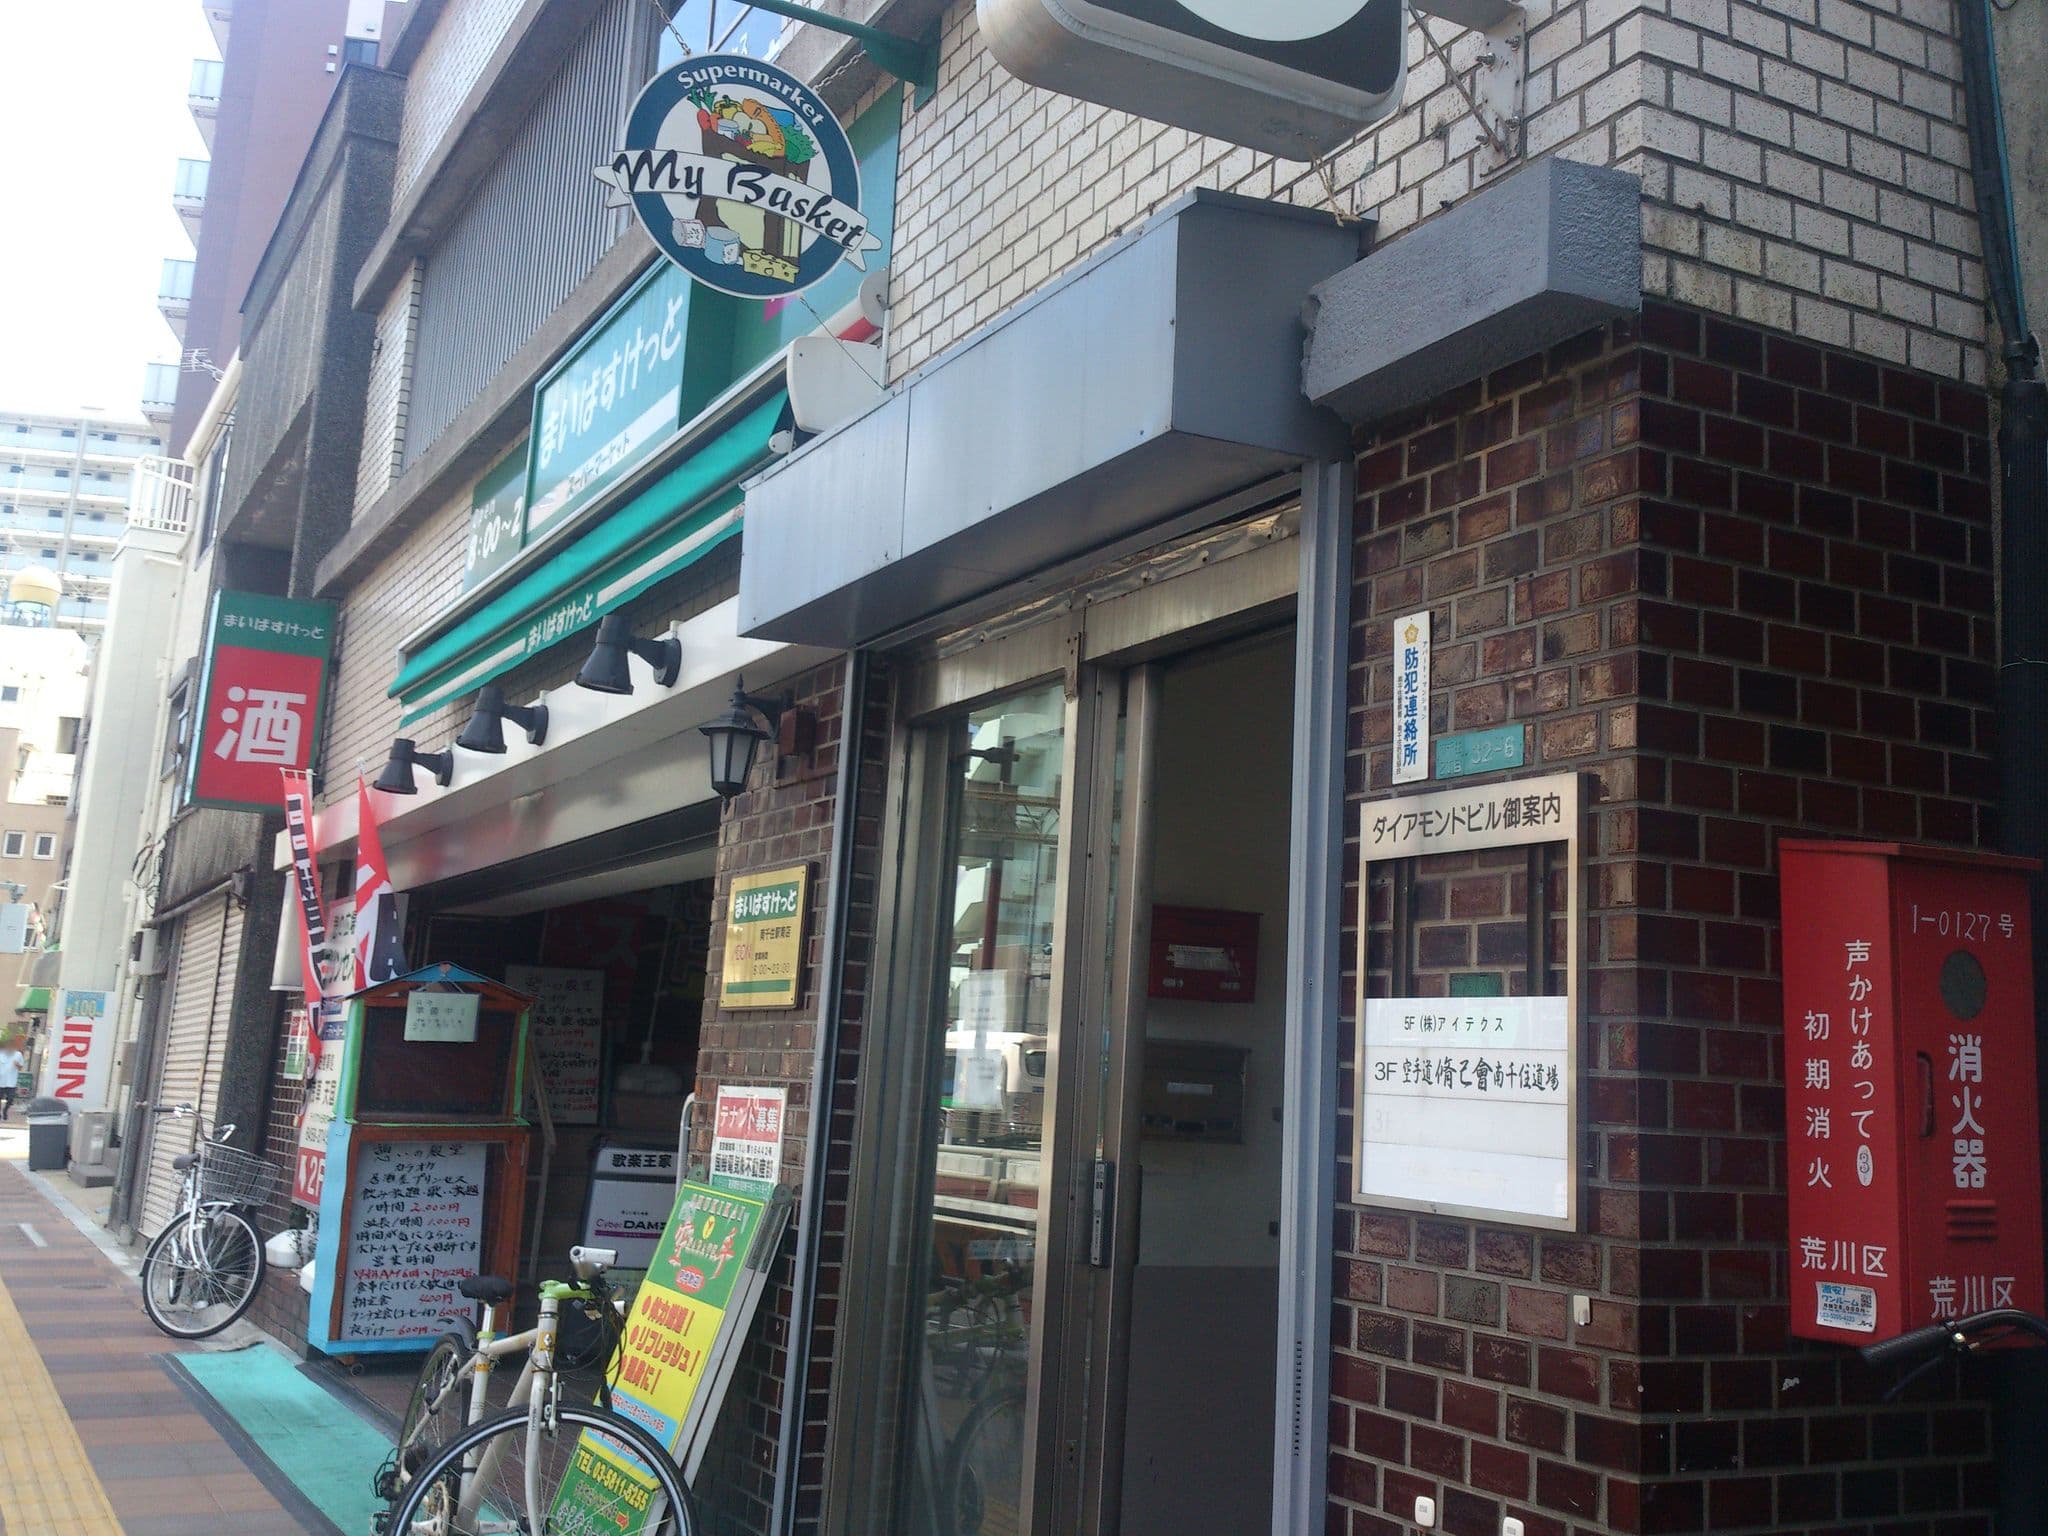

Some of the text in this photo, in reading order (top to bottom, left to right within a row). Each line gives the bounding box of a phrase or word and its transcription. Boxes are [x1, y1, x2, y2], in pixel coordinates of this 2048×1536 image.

[677, 66, 824, 127] Supermarket
[613, 149, 867, 249] My Basket
[540, 297, 683, 470] まいばすけっと
[223, 613, 326, 640] まいばすけっと
[525, 592, 593, 654] まいばすけっと
[214, 686, 307, 766] 酒
[1402, 647, 1419, 767] 防犯連絡所
[1373, 792, 1561, 844] ダイアモンドビル御案内
[735, 889, 797, 919] まいばすけっと
[1404, 1016, 1415, 1031] 5F
[1845, 939, 1875, 1138] 声かけあって
[55, 1016, 94, 1098] IRIN
[1374, 1062, 1398, 1081] 3F
[720, 1104, 777, 1132] テナント募集
[1804, 1010, 1832, 1189] 初期消火
[1948, 1033, 1987, 1189] 消火器
[612, 1154, 672, 1168] 歌楽王家
[1800, 1236, 1888, 1277] 荒川区
[1929, 1275, 2015, 1320] 荒川区
[576, 1448, 593, 1475] TEL
